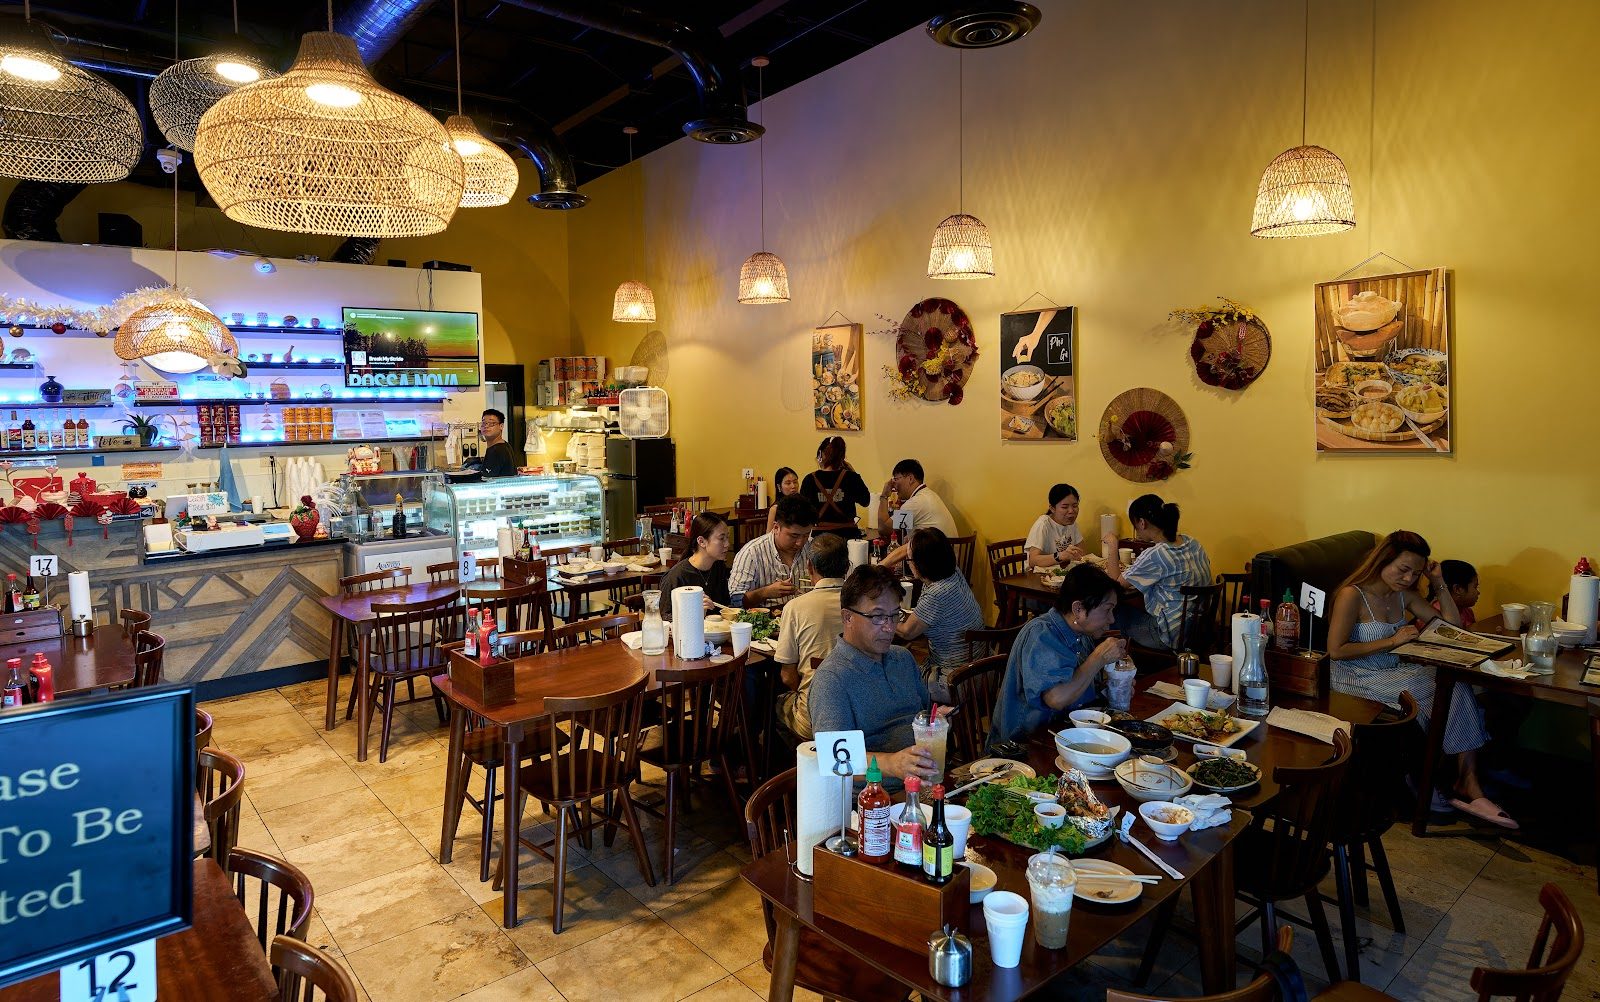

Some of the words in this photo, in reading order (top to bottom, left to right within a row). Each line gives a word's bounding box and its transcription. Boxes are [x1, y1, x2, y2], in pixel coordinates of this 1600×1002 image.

[415, 374, 458, 386] NOVA
[35, 558, 53, 572] 17
[463, 560, 469, 576] 8
[1308, 591, 1316, 606] 5
[832, 738, 851, 762] 6
[0, 826, 51, 864] To
[71, 807, 143, 847] Be
[0, 869, 85, 925] ted
[78, 950, 138, 998] 12
